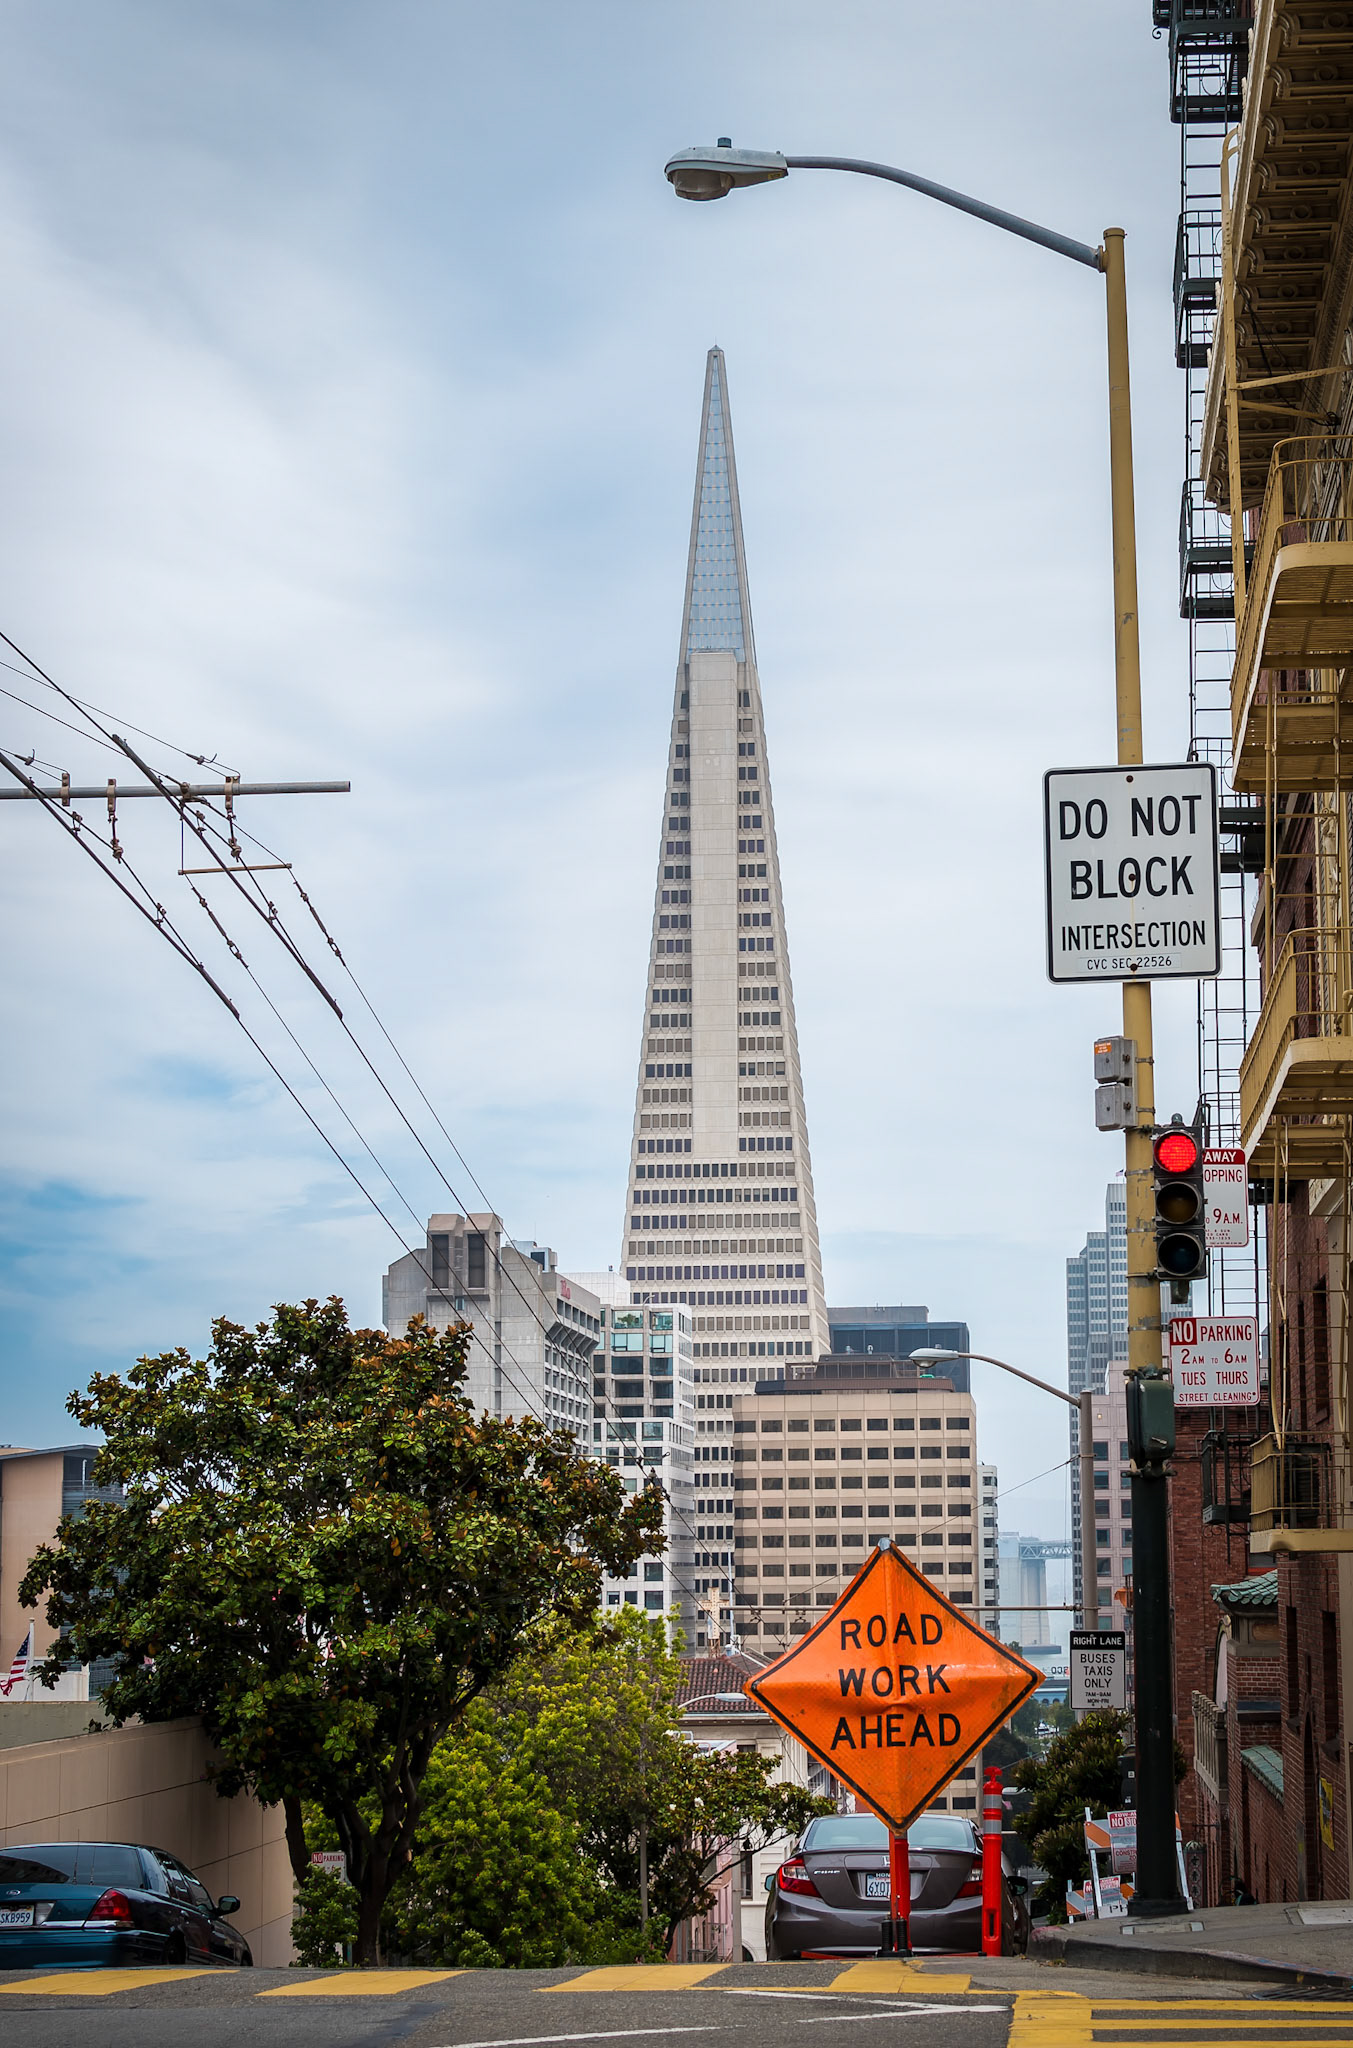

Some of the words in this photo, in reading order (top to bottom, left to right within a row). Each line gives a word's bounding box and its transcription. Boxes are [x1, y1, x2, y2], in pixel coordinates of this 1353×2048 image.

[1059, 799, 1108, 840] DO
[1131, 795, 1202, 837] NOT
[1070, 855, 1194, 900] BLOCK
[1062, 920, 1206, 951] INTERSECTION
[1087, 958, 1108, 970] CVC
[1136, 955, 1172, 968] 22526
[1172, 1320, 1194, 1343] NO
[1200, 1324, 1252, 1342] PARKING
[1181, 1372, 1207, 1386] TUES
[1216, 1371, 1249, 1385] THURS
[1179, 1393, 1208, 1402] STREET
[1213, 1392, 1252, 1401] CLEANING
[840, 1612, 943, 1651] ROAD
[1073, 1636, 1097, 1645] RIGHT
[1100, 1636, 1122, 1645] LANE
[1080, 1653, 1116, 1664] BUSES
[1083, 1666, 1113, 1676] TAXIS
[838, 1663, 951, 1697] WORK
[1084, 1678, 1112, 1688] ONLY
[830, 1713, 961, 1751] AHEAD
[1111, 1817, 1124, 1827] NO
[313, 1853, 323, 1863] NO
